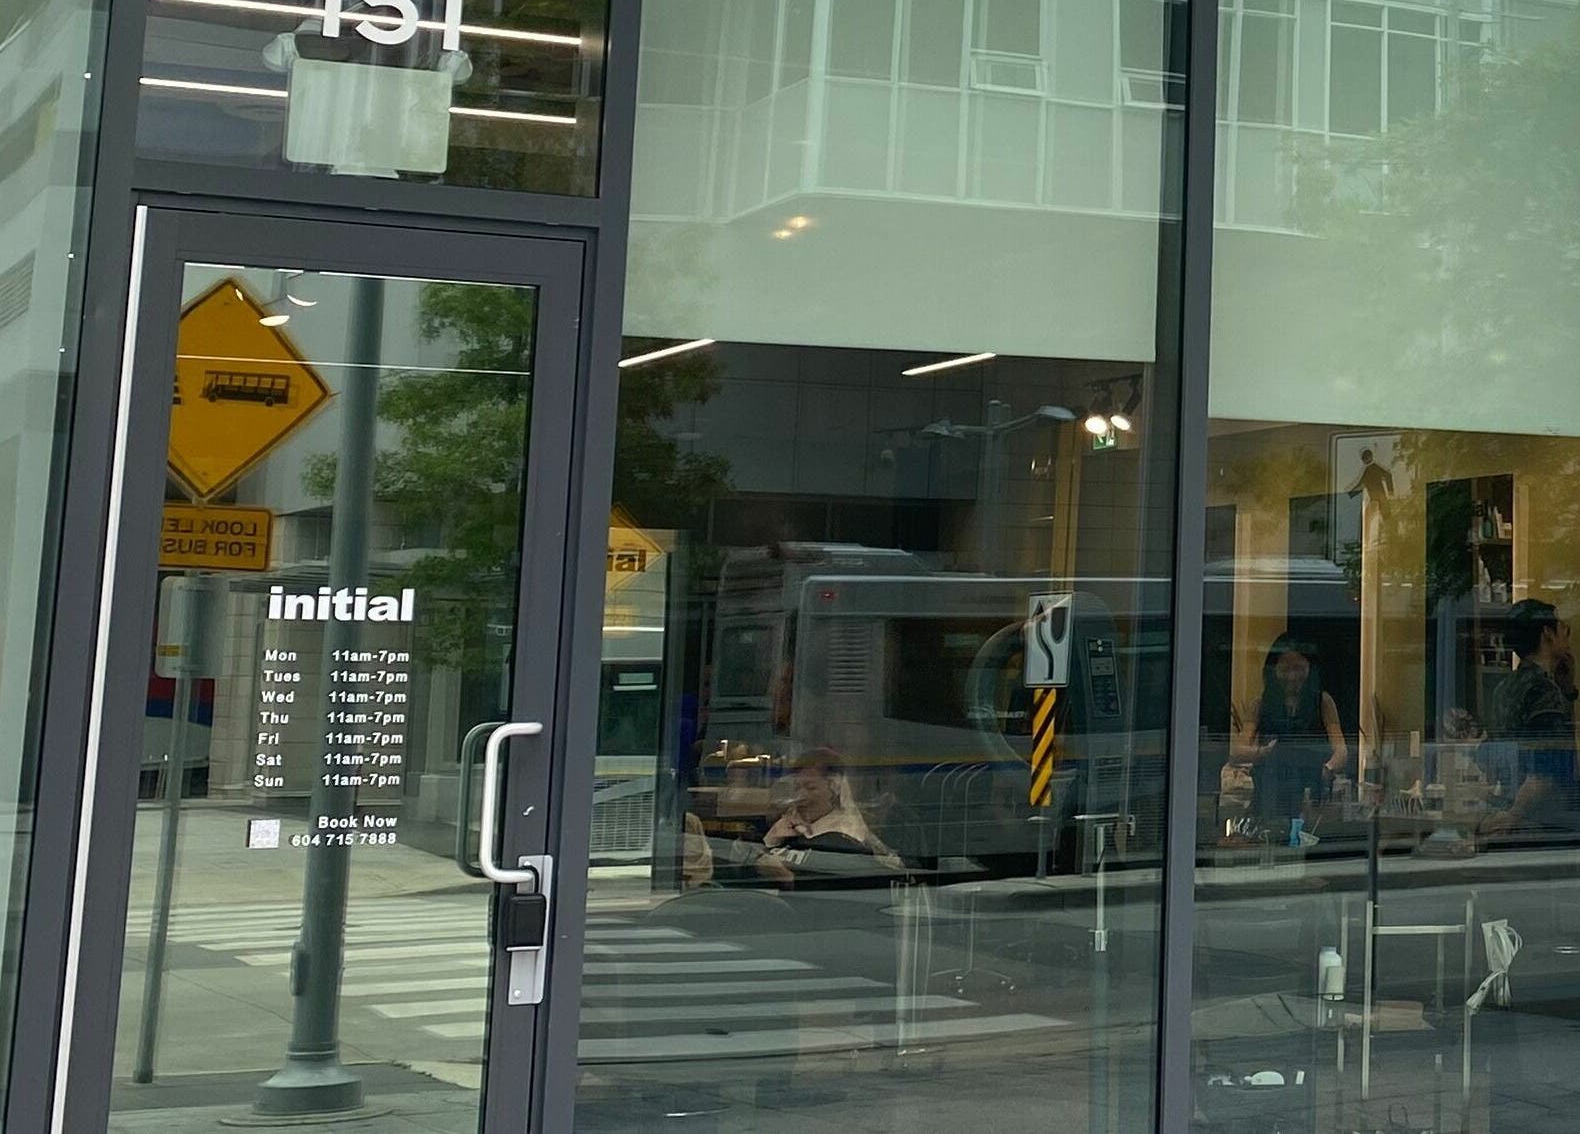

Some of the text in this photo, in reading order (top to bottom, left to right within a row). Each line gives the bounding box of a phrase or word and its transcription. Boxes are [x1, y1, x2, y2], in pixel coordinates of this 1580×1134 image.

[268, 586, 415, 622] initial
[265, 649, 410, 664] Mon 11am-7pm
[263, 669, 408, 684] Tues 11am-7pm
[261, 690, 407, 705] Wed 11am-7pm
[260, 711, 405, 725] Thu 11am-7pm
[258, 732, 403, 746] Fri 11am-7pm
[255, 753, 402, 766] Sat 11am-7pm
[254, 773, 400, 787] Sun 11am-7pm
[318, 815, 398, 829] Book Now
[291, 832, 397, 847] 604 715 7888
